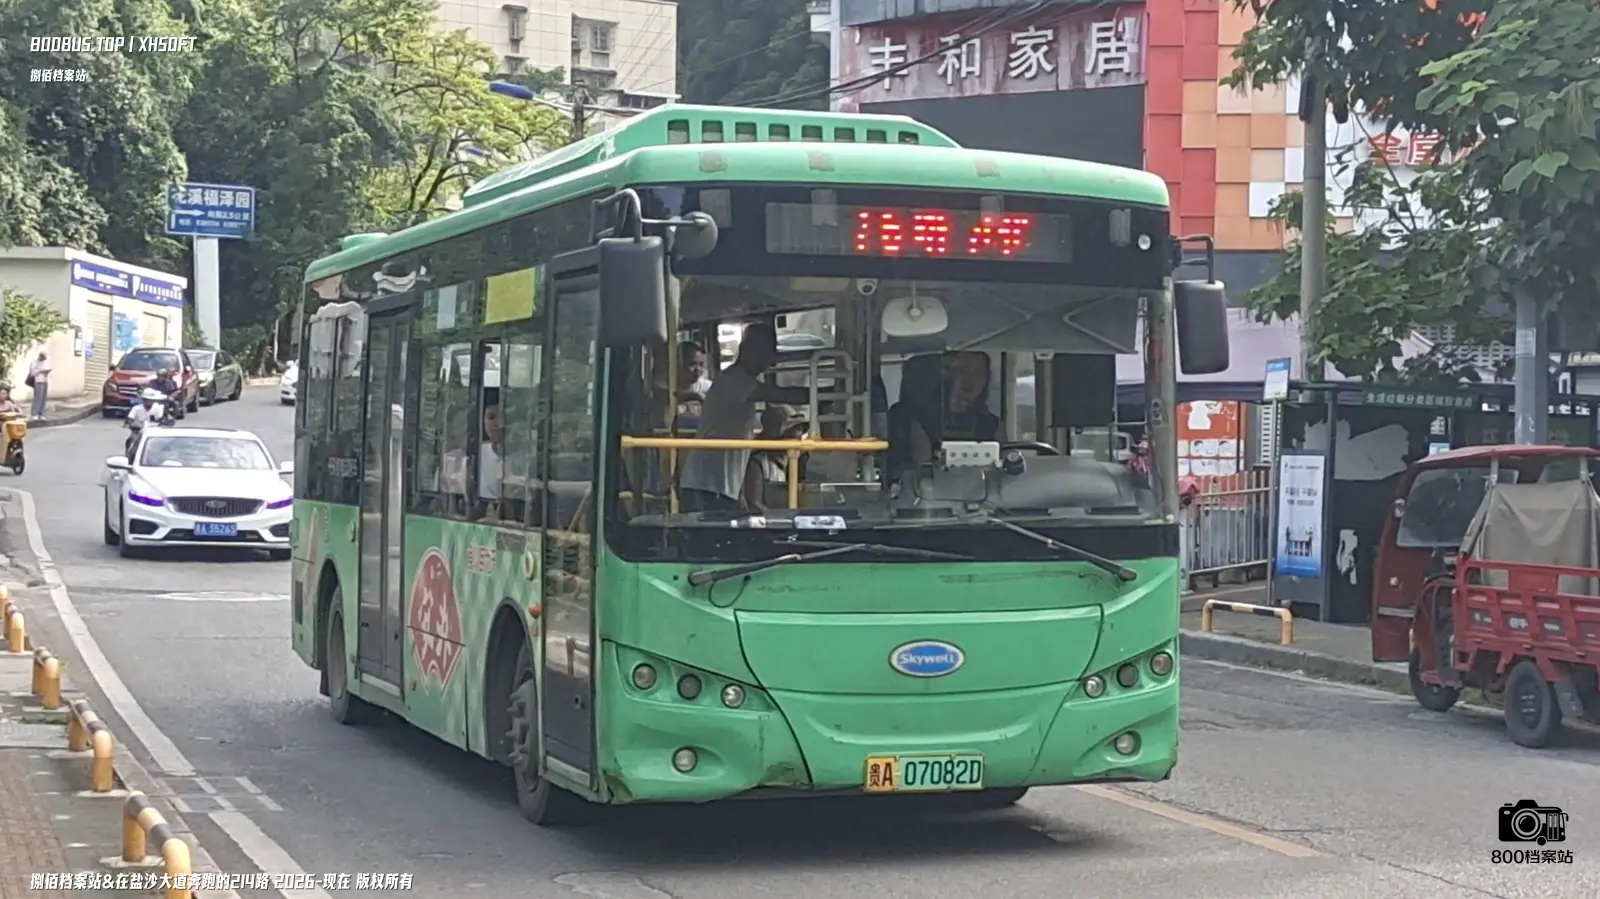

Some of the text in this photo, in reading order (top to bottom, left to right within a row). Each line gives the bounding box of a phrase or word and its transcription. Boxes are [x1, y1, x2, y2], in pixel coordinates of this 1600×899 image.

[868, 21, 1131, 90] 丰和家居
[900, 653, 955, 666] Skywell
